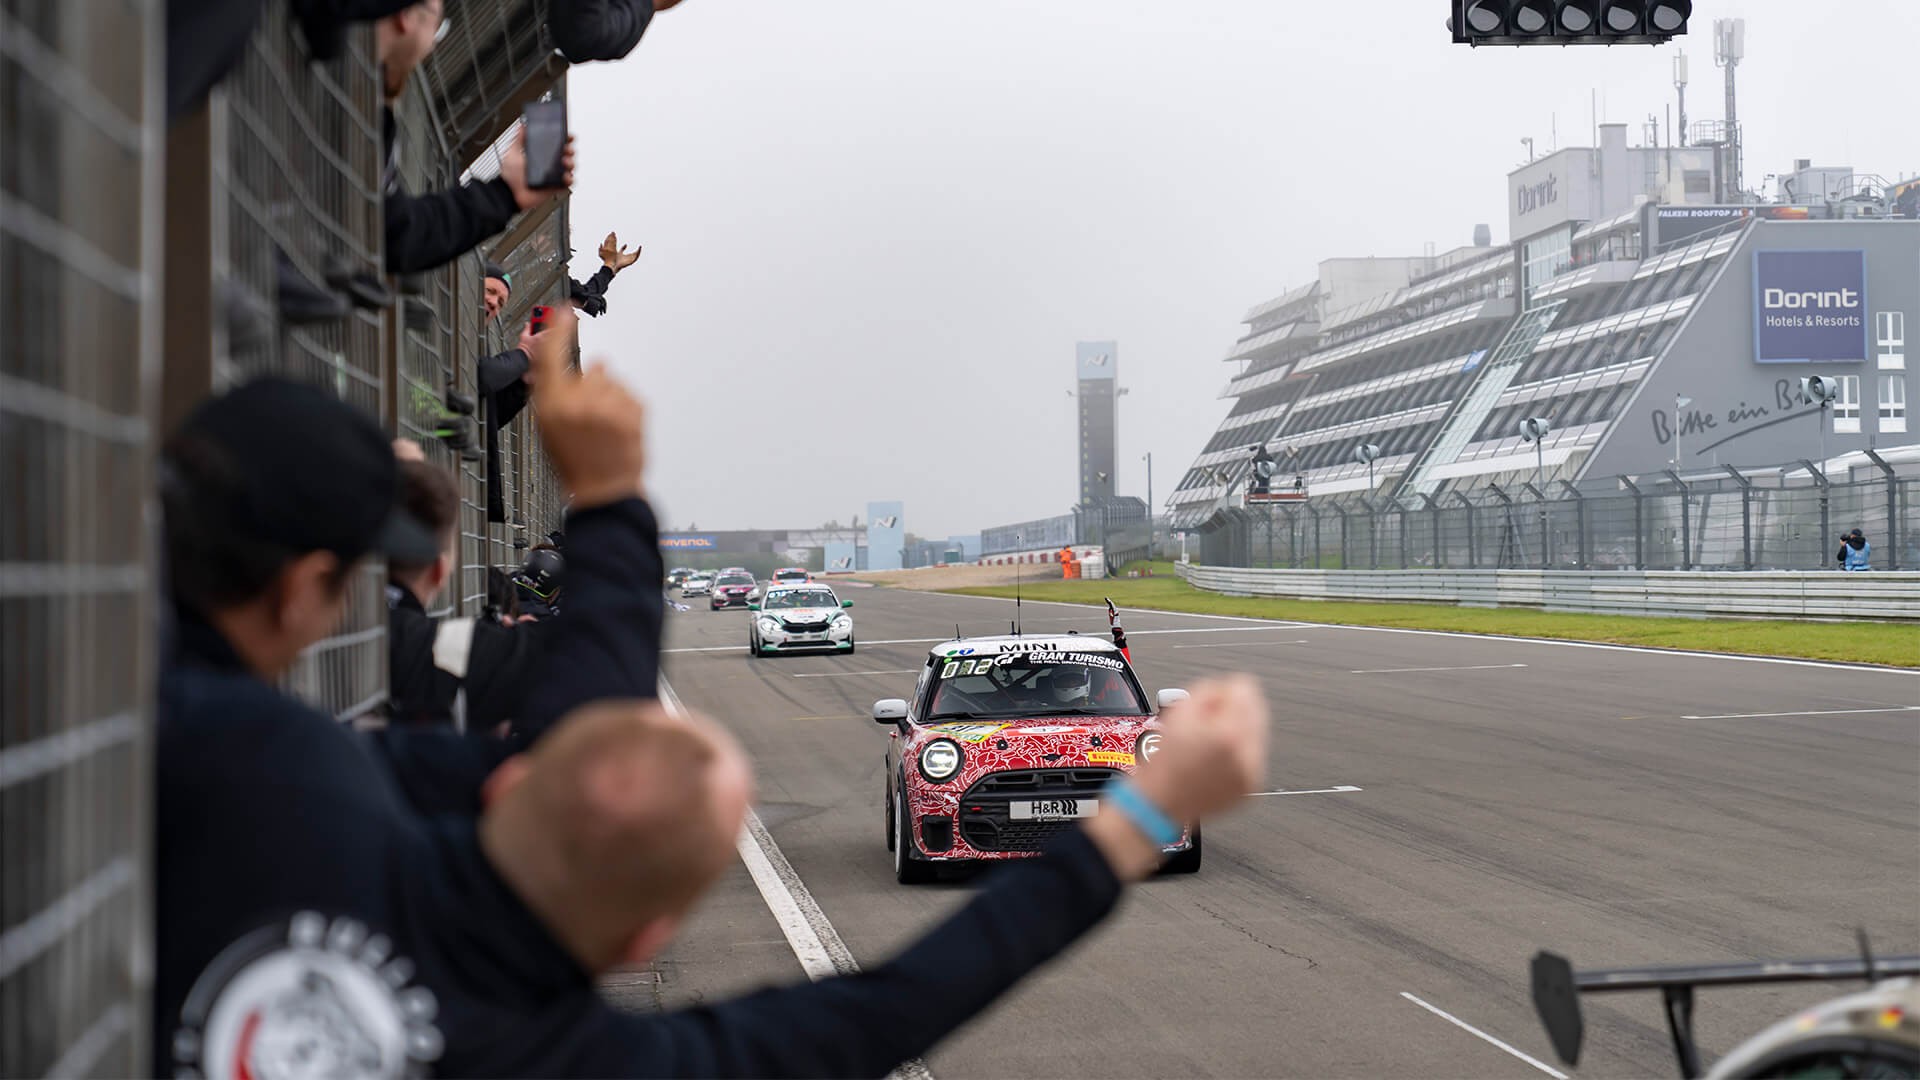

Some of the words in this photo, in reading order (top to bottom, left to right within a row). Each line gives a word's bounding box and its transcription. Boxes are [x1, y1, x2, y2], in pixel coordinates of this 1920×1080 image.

[1517, 171, 1558, 216] Dorint
[1658, 209, 1689, 217] FALKEN
[1691, 209, 1730, 217] ROOFTOP
[1764, 287, 1859, 309] Dorint
[1766, 315, 1803, 327] Hotels
[1805, 315, 1813, 327] &
[1815, 315, 1860, 327] Resorts
[1728, 402, 1769, 423] ein
[1774, 378, 1804, 410] Bi
[999, 643, 1057, 653] MINI
[940, 658, 994, 680] 072
[1028, 651, 1065, 661] GRAN
[1069, 651, 1125, 670] TURISMO
[1031, 801, 1060, 814] H&R
